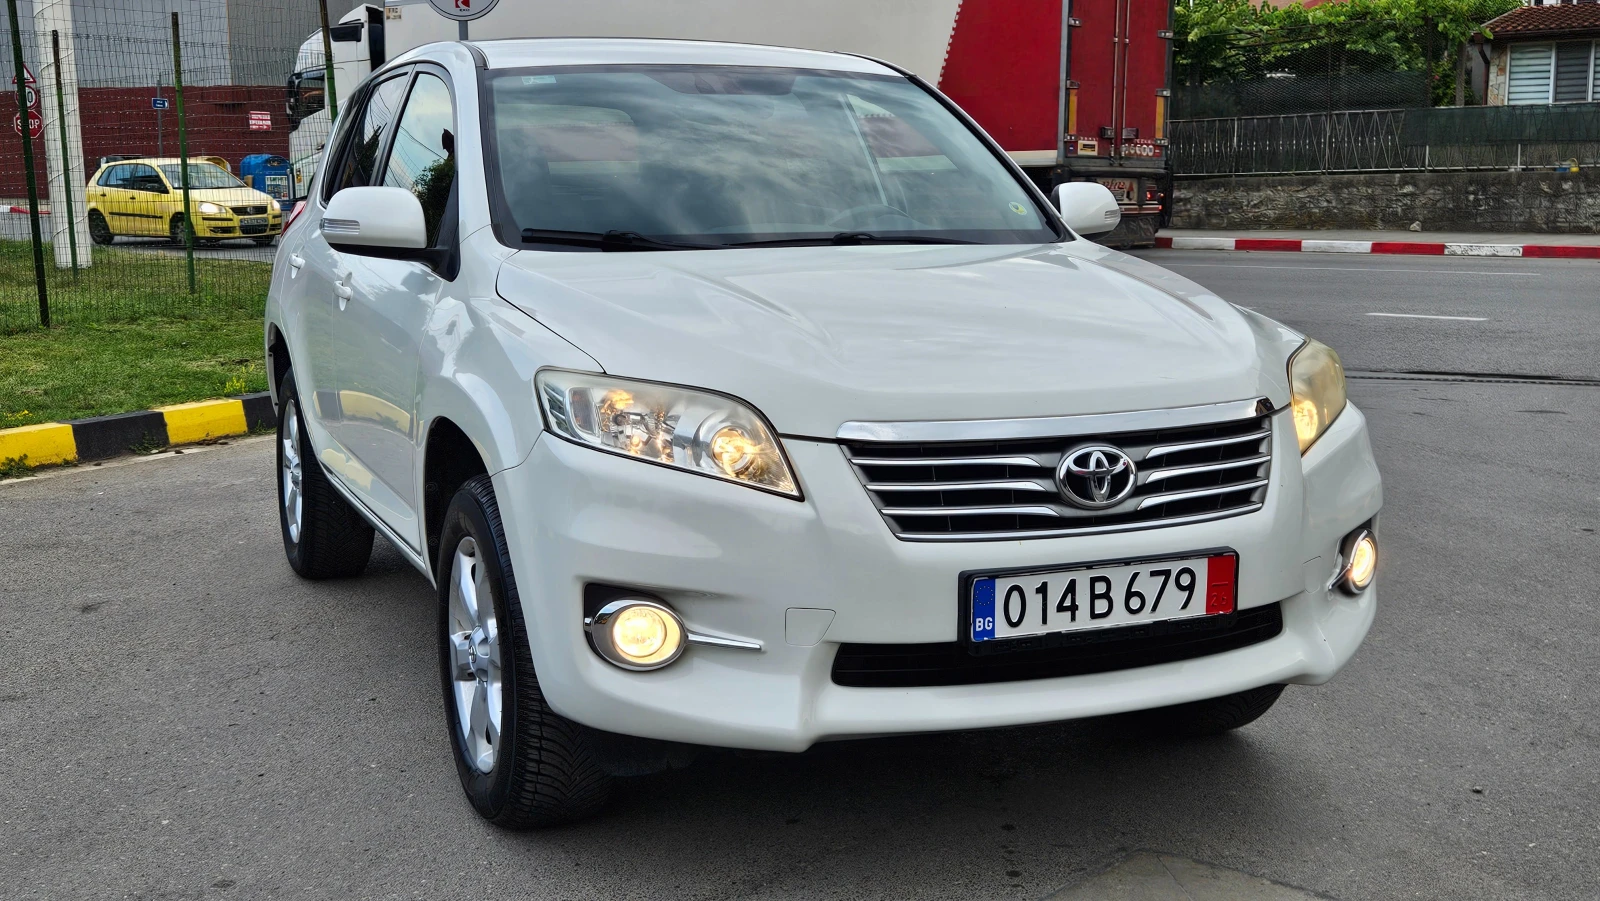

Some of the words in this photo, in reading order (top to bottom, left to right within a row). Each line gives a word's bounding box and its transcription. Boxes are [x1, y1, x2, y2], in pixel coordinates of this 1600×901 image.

[17, 119, 39, 129] SOP
[1003, 567, 1197, 628] 014B679
[975, 617, 993, 632] BG
